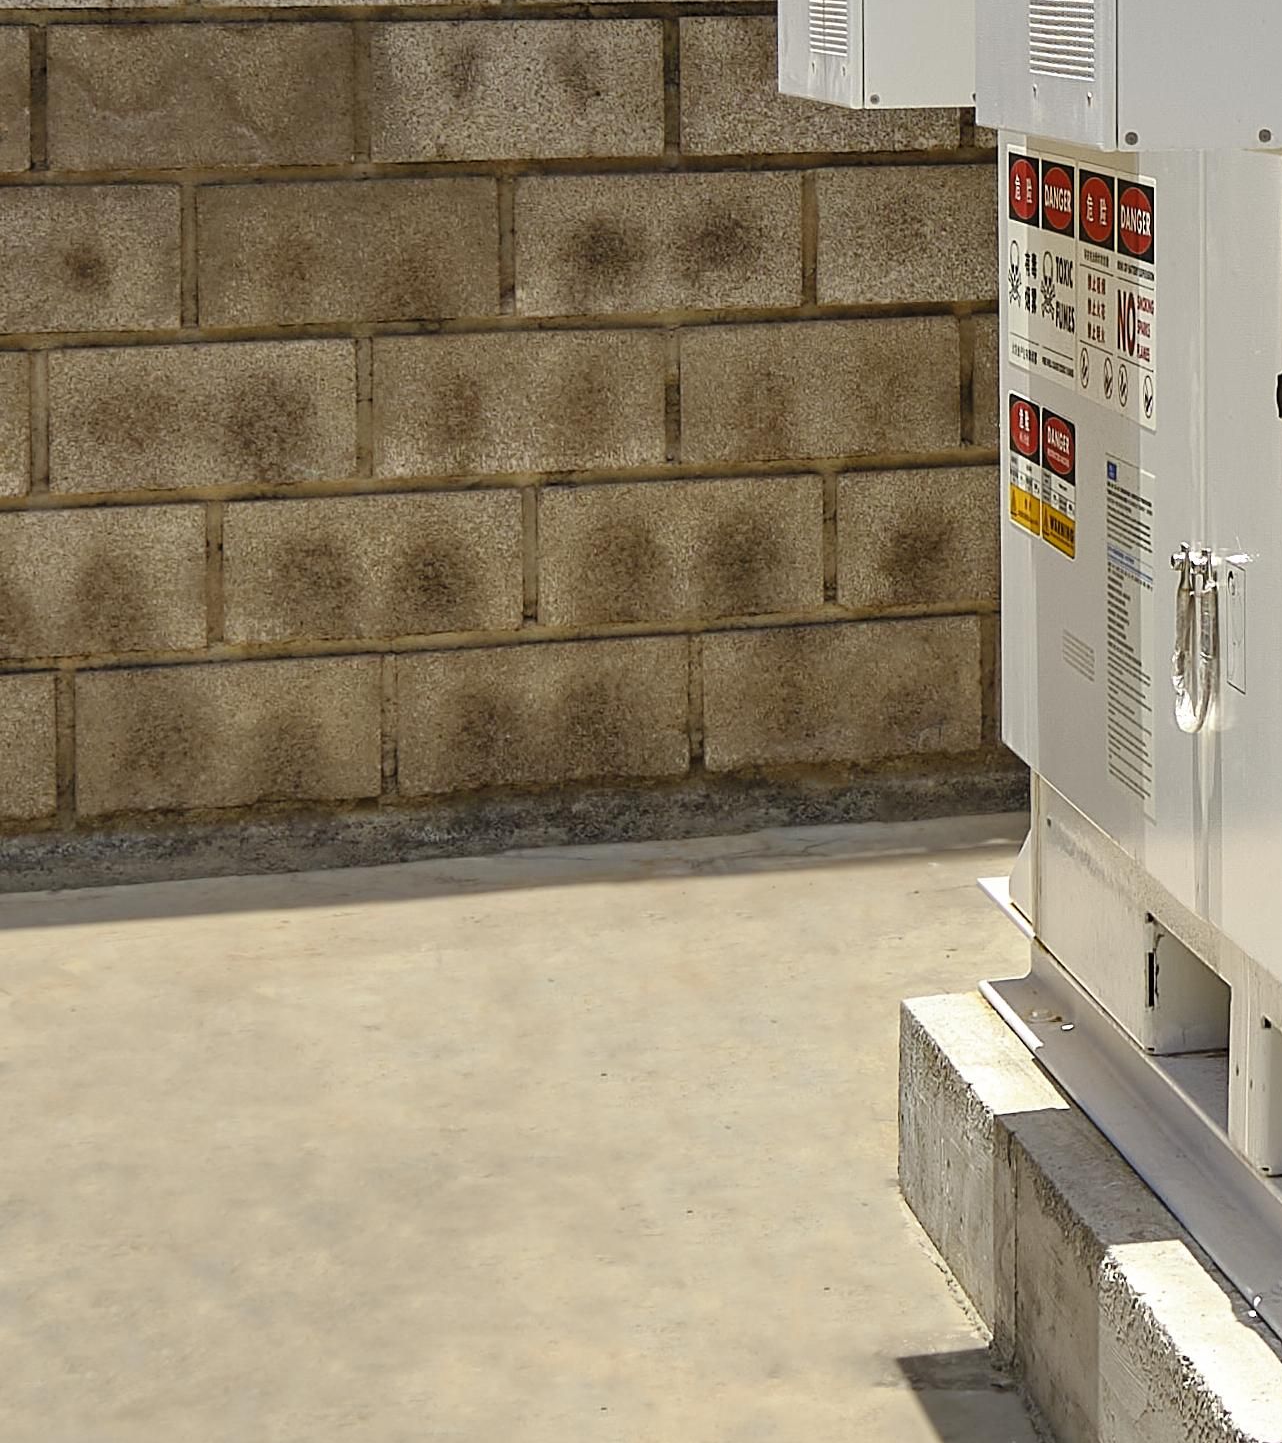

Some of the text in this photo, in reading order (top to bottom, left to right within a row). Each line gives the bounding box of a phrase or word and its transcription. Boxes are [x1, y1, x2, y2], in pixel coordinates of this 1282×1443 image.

[1044, 184, 1072, 213] DANGER
[1120, 204, 1152, 237] DANGER
[1055, 256, 1074, 289] TOXIC
[1055, 301, 1075, 335] FUMES
[1117, 289, 1136, 356] NO
[1047, 426, 1070, 455] DANGER
